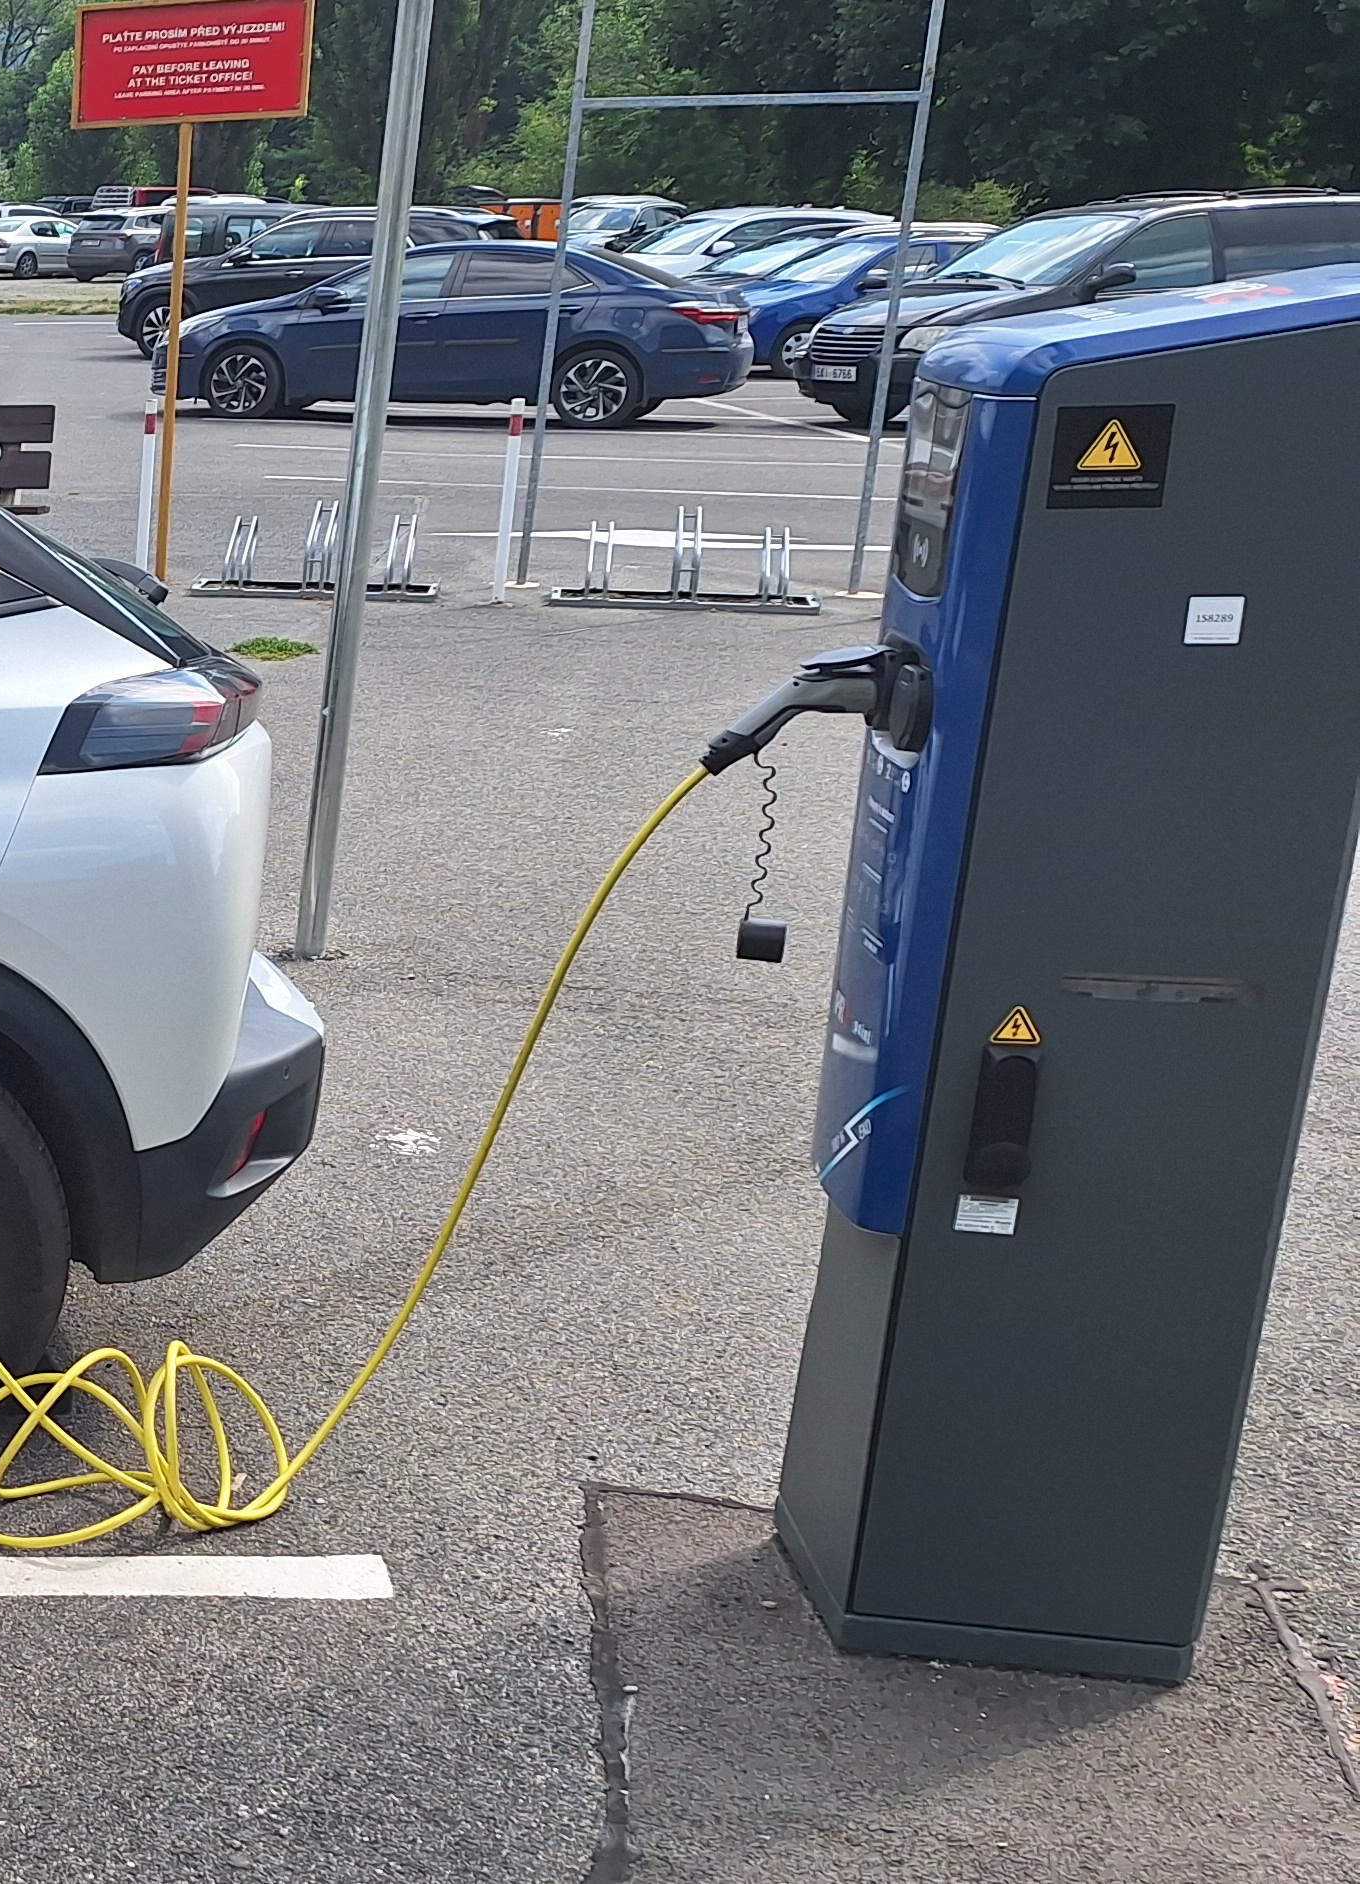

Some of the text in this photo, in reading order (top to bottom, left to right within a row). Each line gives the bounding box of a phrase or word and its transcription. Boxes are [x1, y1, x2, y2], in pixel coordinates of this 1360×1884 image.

[145, 27, 187, 40] PROSÍM
[190, 24, 220, 37] PŘED
[222, 21, 285, 36] VÝJEZDEM!
[132, 58, 250, 75] PAY BEFORE LEAVING
[127, 71, 253, 88] AT THE TICKET OFFICE!
[1195, 613, 1234, 623] 158289
